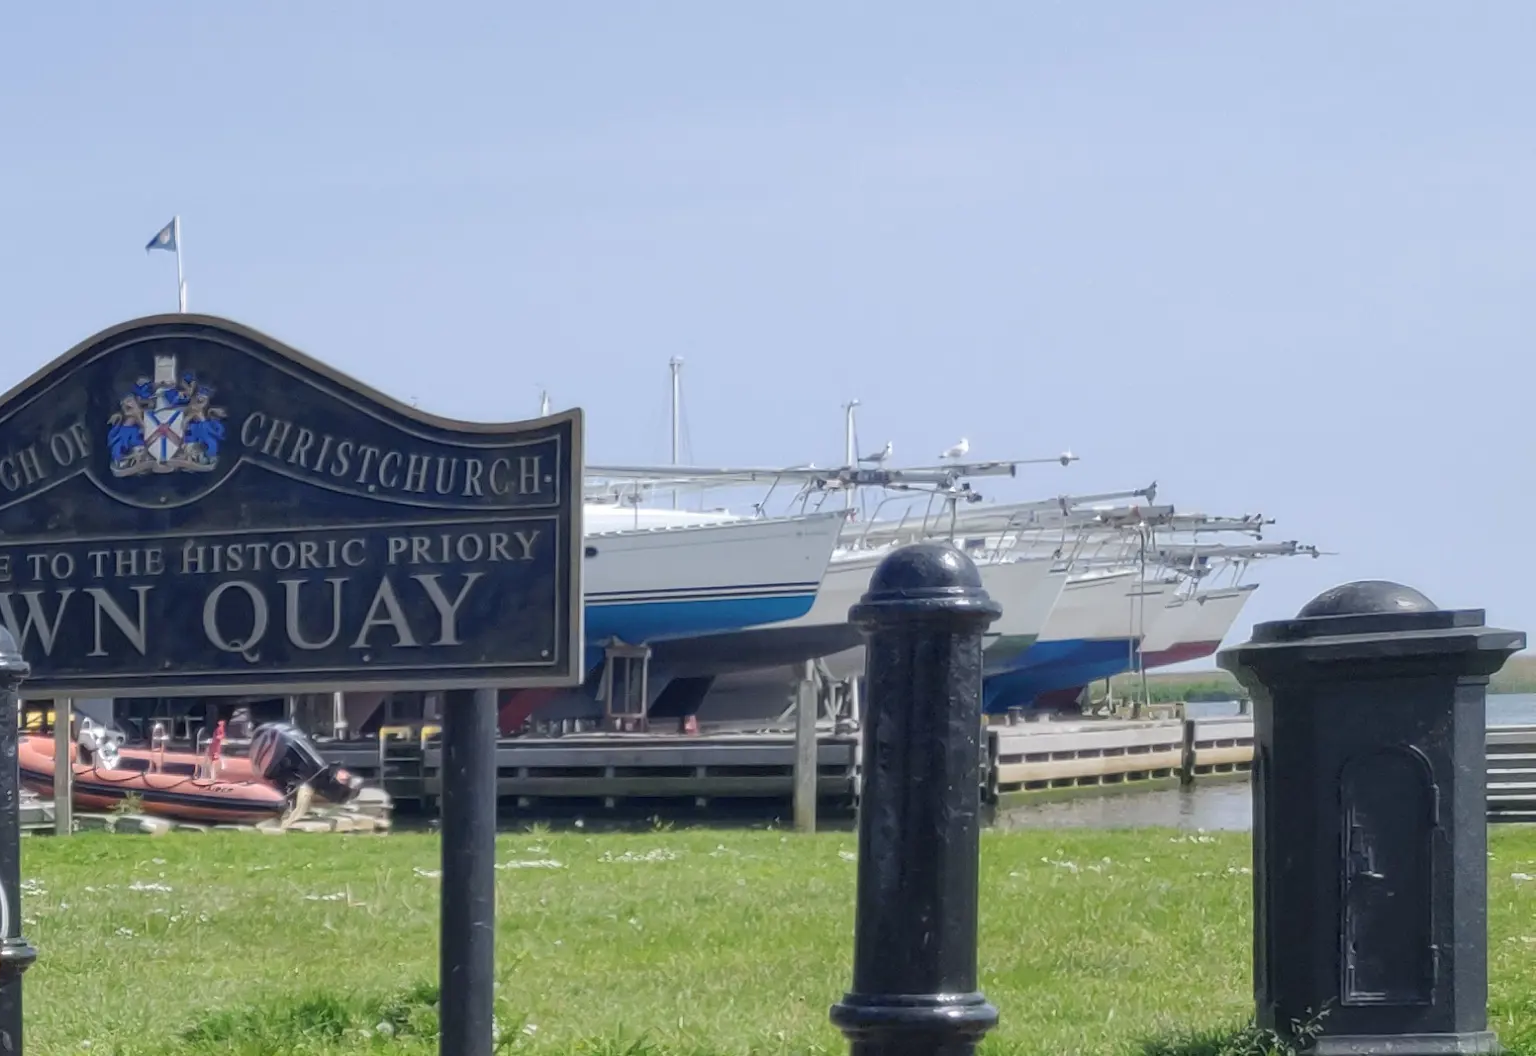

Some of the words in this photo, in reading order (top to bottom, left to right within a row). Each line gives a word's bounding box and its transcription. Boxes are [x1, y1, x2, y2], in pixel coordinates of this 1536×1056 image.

[49, 428, 92, 467] OF
[240, 411, 543, 497] CHRISTCHURCH
[27, 552, 76, 582] TO
[87, 549, 165, 579] THE
[179, 538, 366, 575] HISTORIC
[387, 530, 541, 565] PRIORY
[202, 572, 485, 664] QUAY
